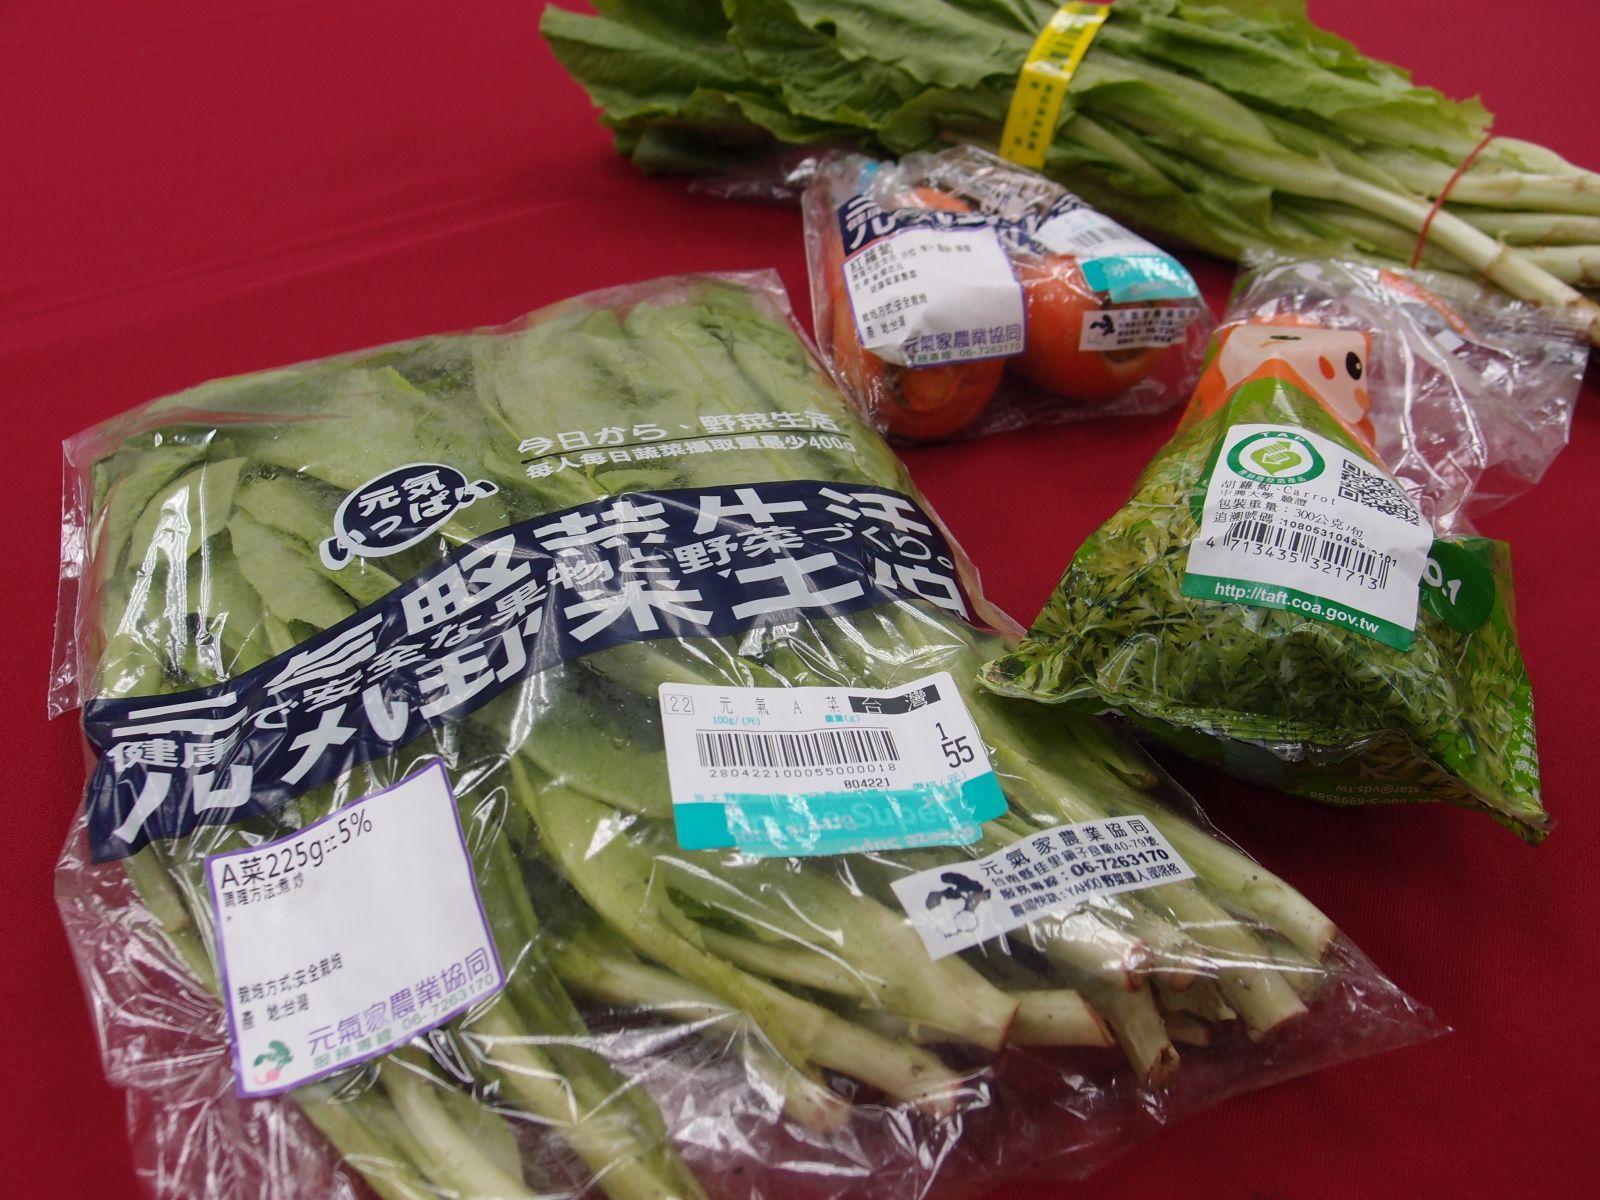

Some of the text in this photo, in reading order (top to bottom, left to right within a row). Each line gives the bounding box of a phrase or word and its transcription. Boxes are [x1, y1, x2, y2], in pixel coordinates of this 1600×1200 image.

[1260, 431, 1306, 442] TAP
[1214, 582, 1380, 634] http://taft.coa.gov.tw
[941, 735, 975, 768] 55
[843, 777, 891, 790] 804221
[979, 819, 1150, 877] 元氣家農業協同
[308, 947, 491, 1055] 元氣家農業協同
